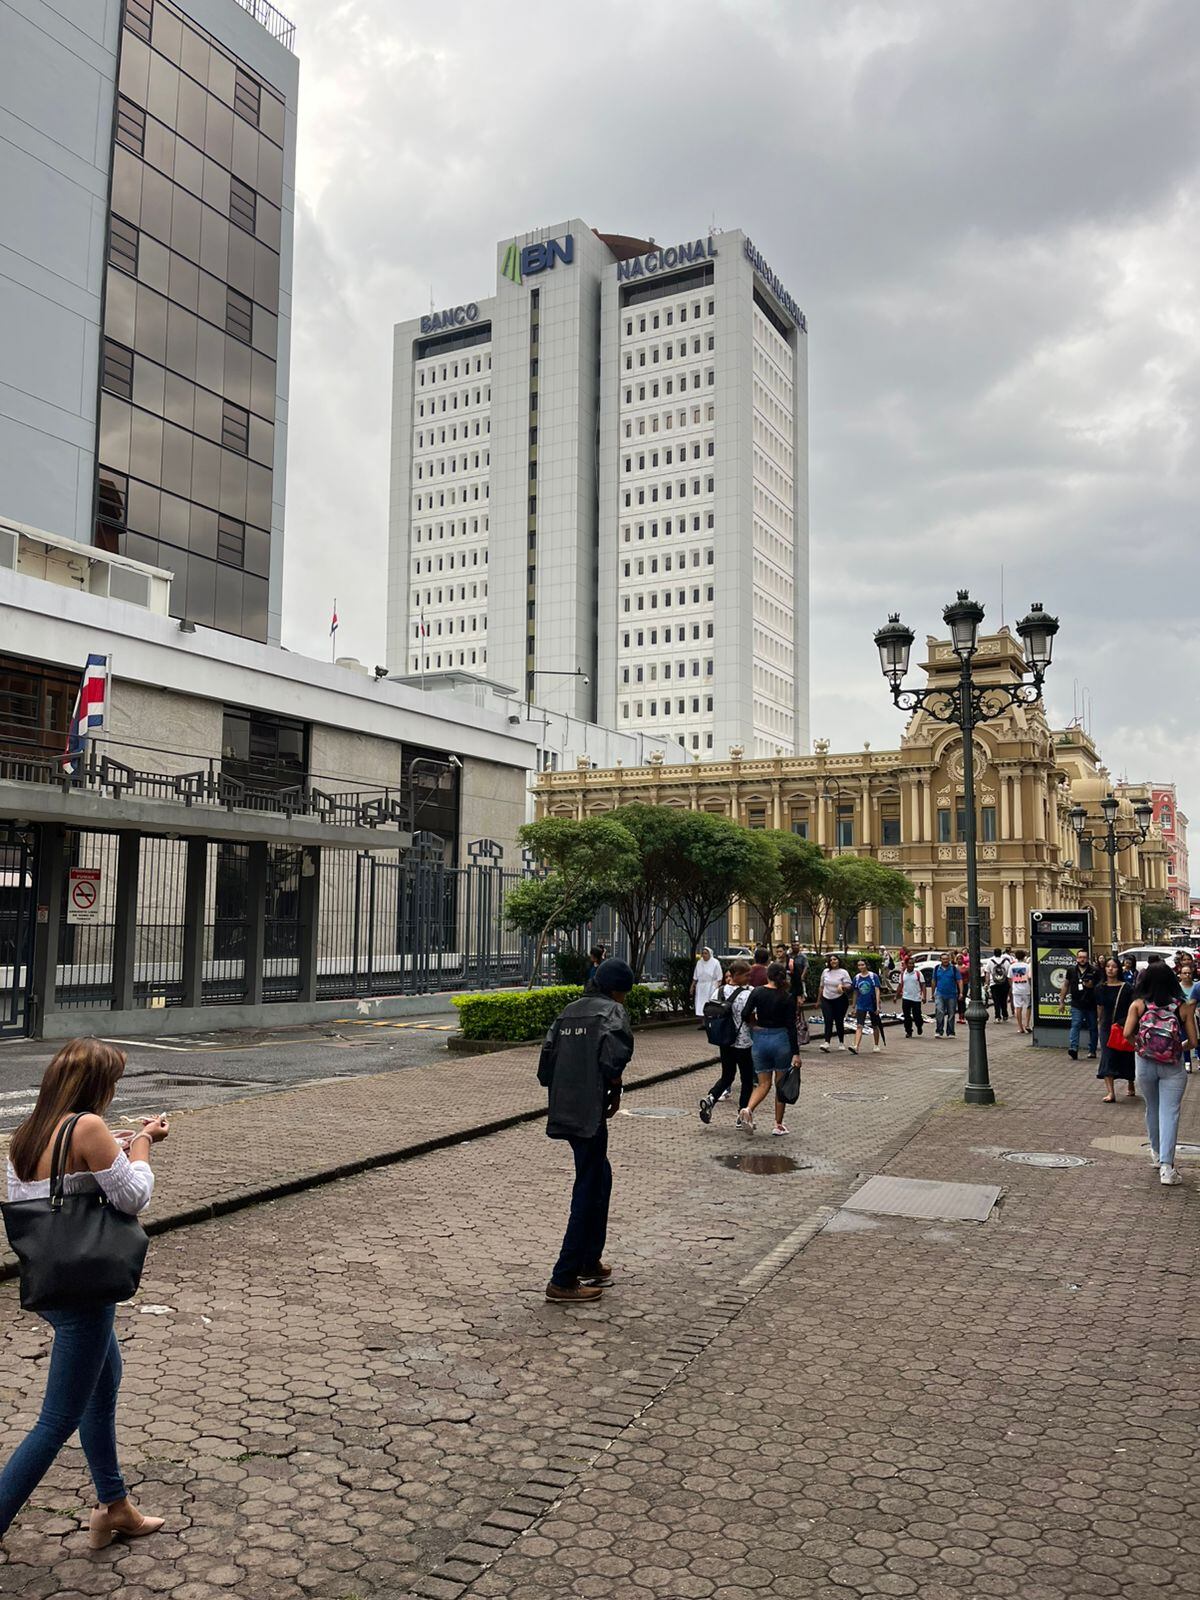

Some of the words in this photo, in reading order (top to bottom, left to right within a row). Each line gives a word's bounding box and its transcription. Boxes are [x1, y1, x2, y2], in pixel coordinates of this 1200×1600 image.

[521, 234, 574, 277] BN
[617, 236, 718, 281] NACIONAL
[744, 237, 773, 285] BANCO
[420, 302, 480, 334] BANCO
